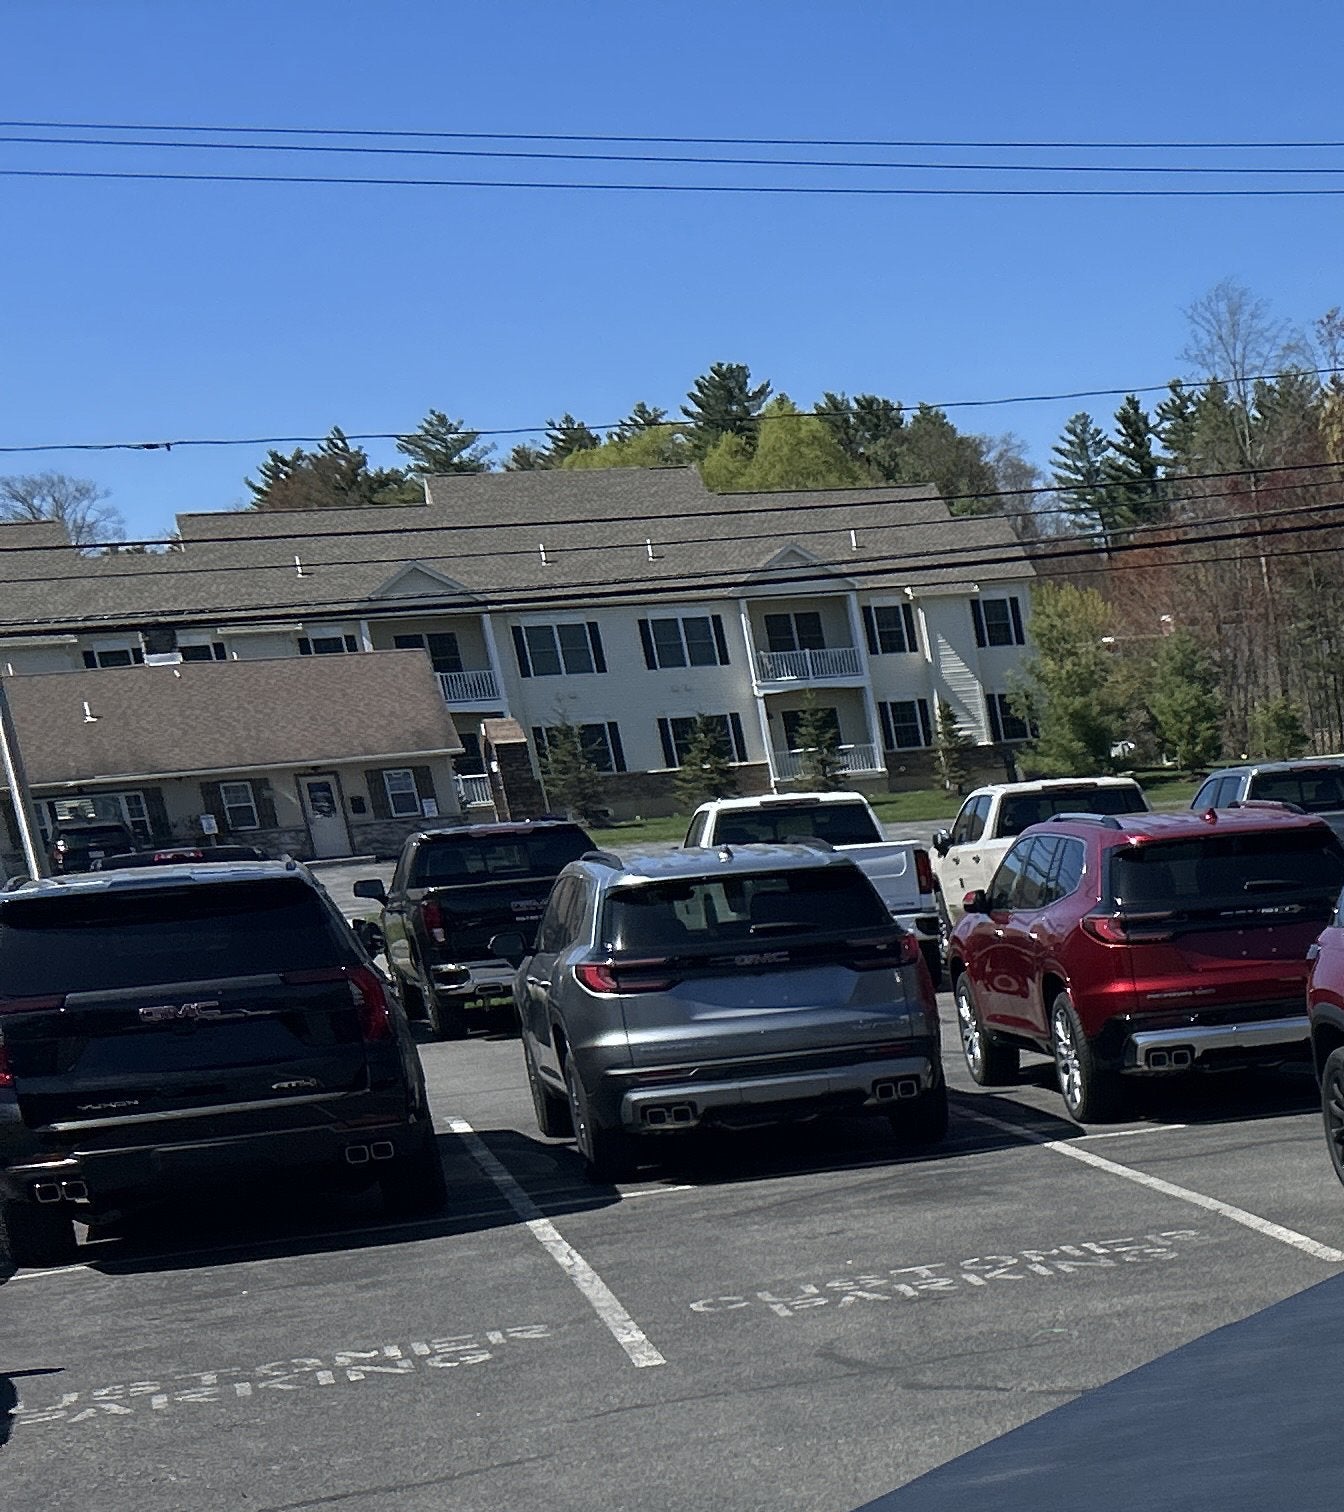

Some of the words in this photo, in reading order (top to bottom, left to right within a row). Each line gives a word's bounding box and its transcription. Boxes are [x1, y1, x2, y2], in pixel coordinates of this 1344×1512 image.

[689, 1229, 1200, 1312] CUSTOMER
[768, 1246, 1179, 1317] PARKING
[7, 1324, 552, 1414] USTOMER
[19, 1348, 494, 1425] PARKING
